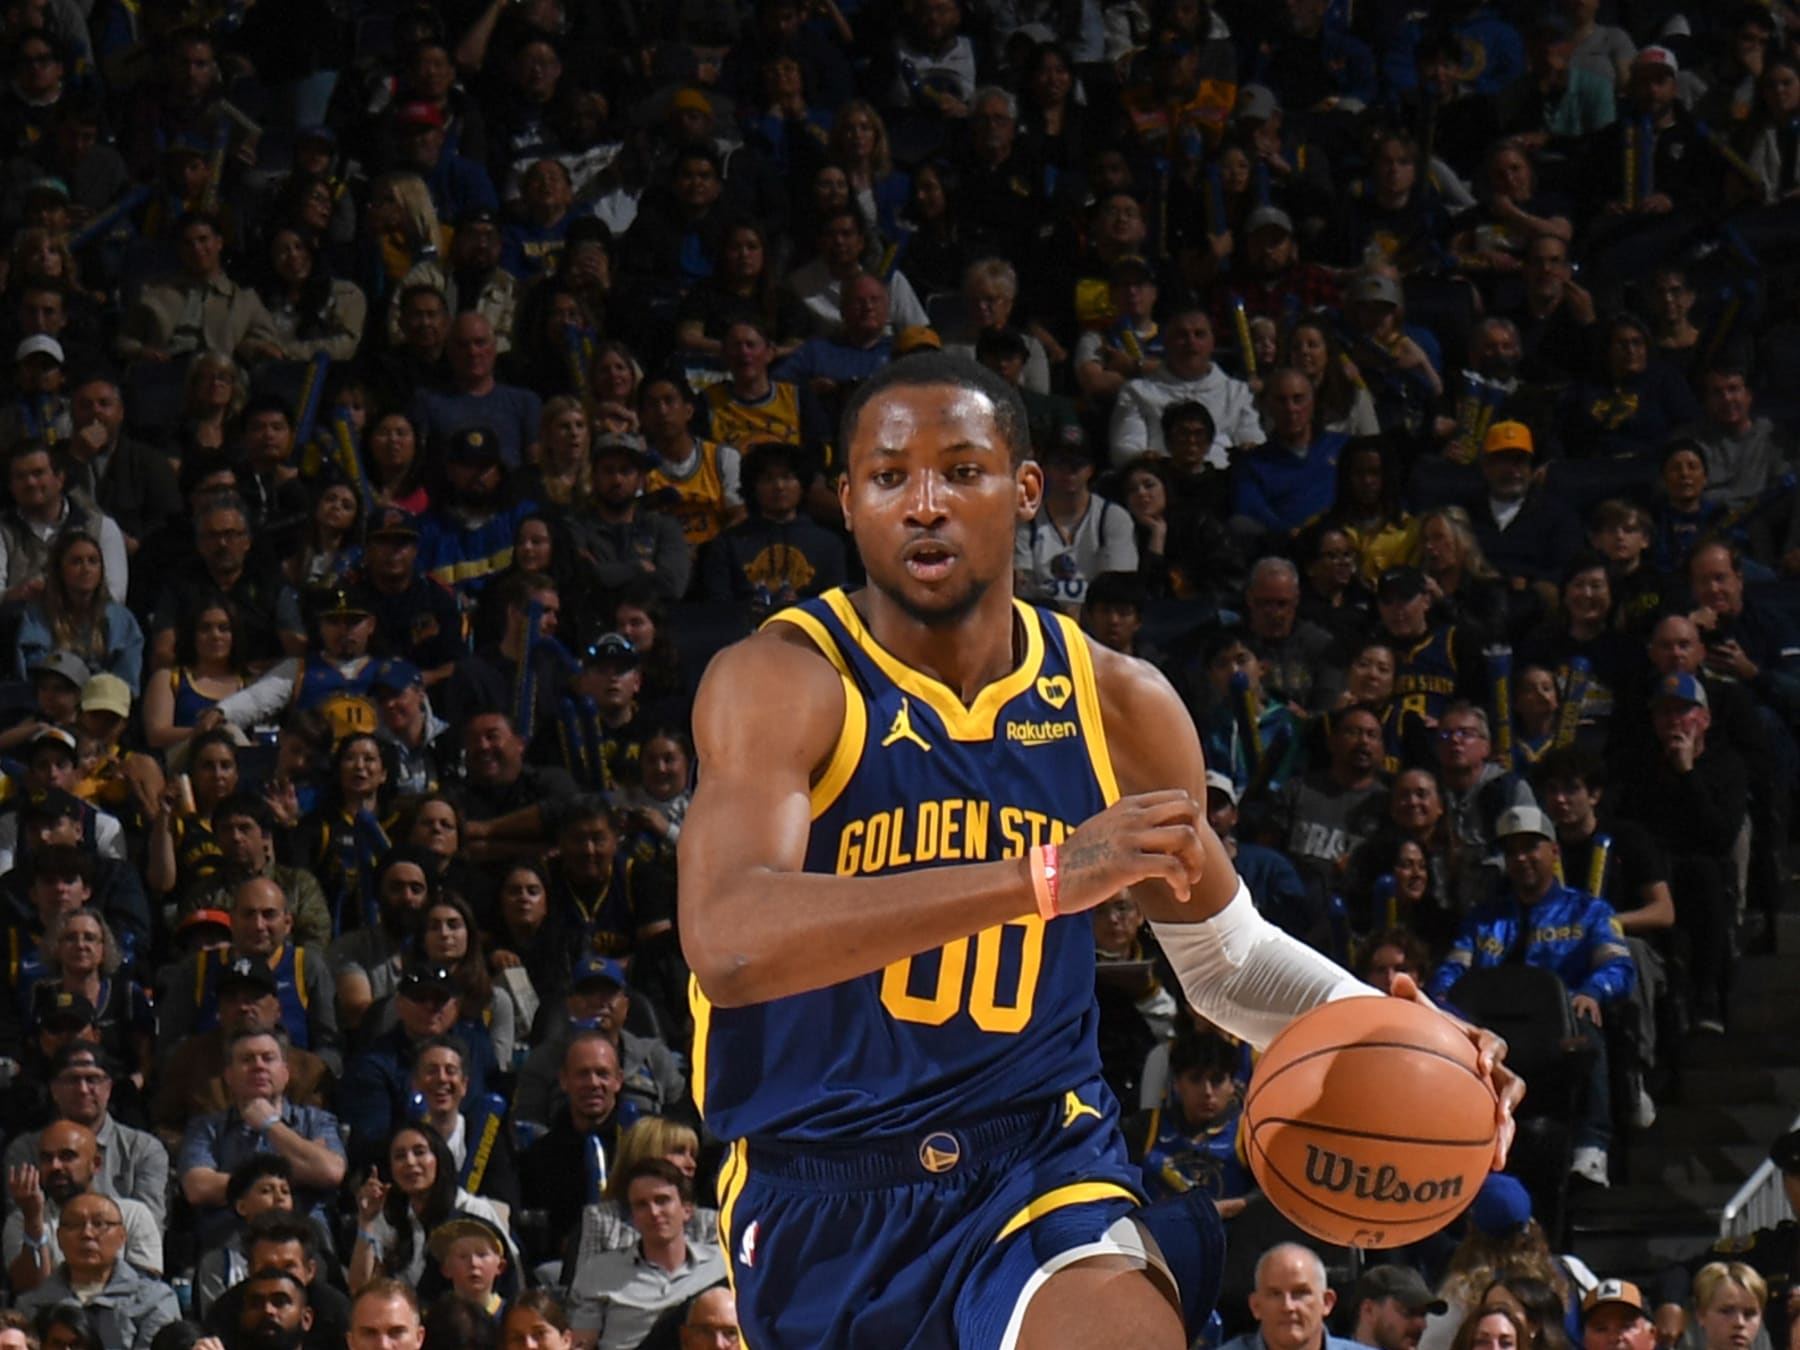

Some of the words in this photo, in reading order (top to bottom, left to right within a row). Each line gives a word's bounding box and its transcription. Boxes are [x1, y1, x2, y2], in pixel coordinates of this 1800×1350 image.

[1041, 578, 1083, 598] 30
[1006, 720, 1078, 740] Rakuten
[836, 799, 990, 876] GOLDEN
[1000, 806, 1076, 861] STA
[880, 912, 1047, 1034] 00
[1305, 1143, 1464, 1203] Wilson
